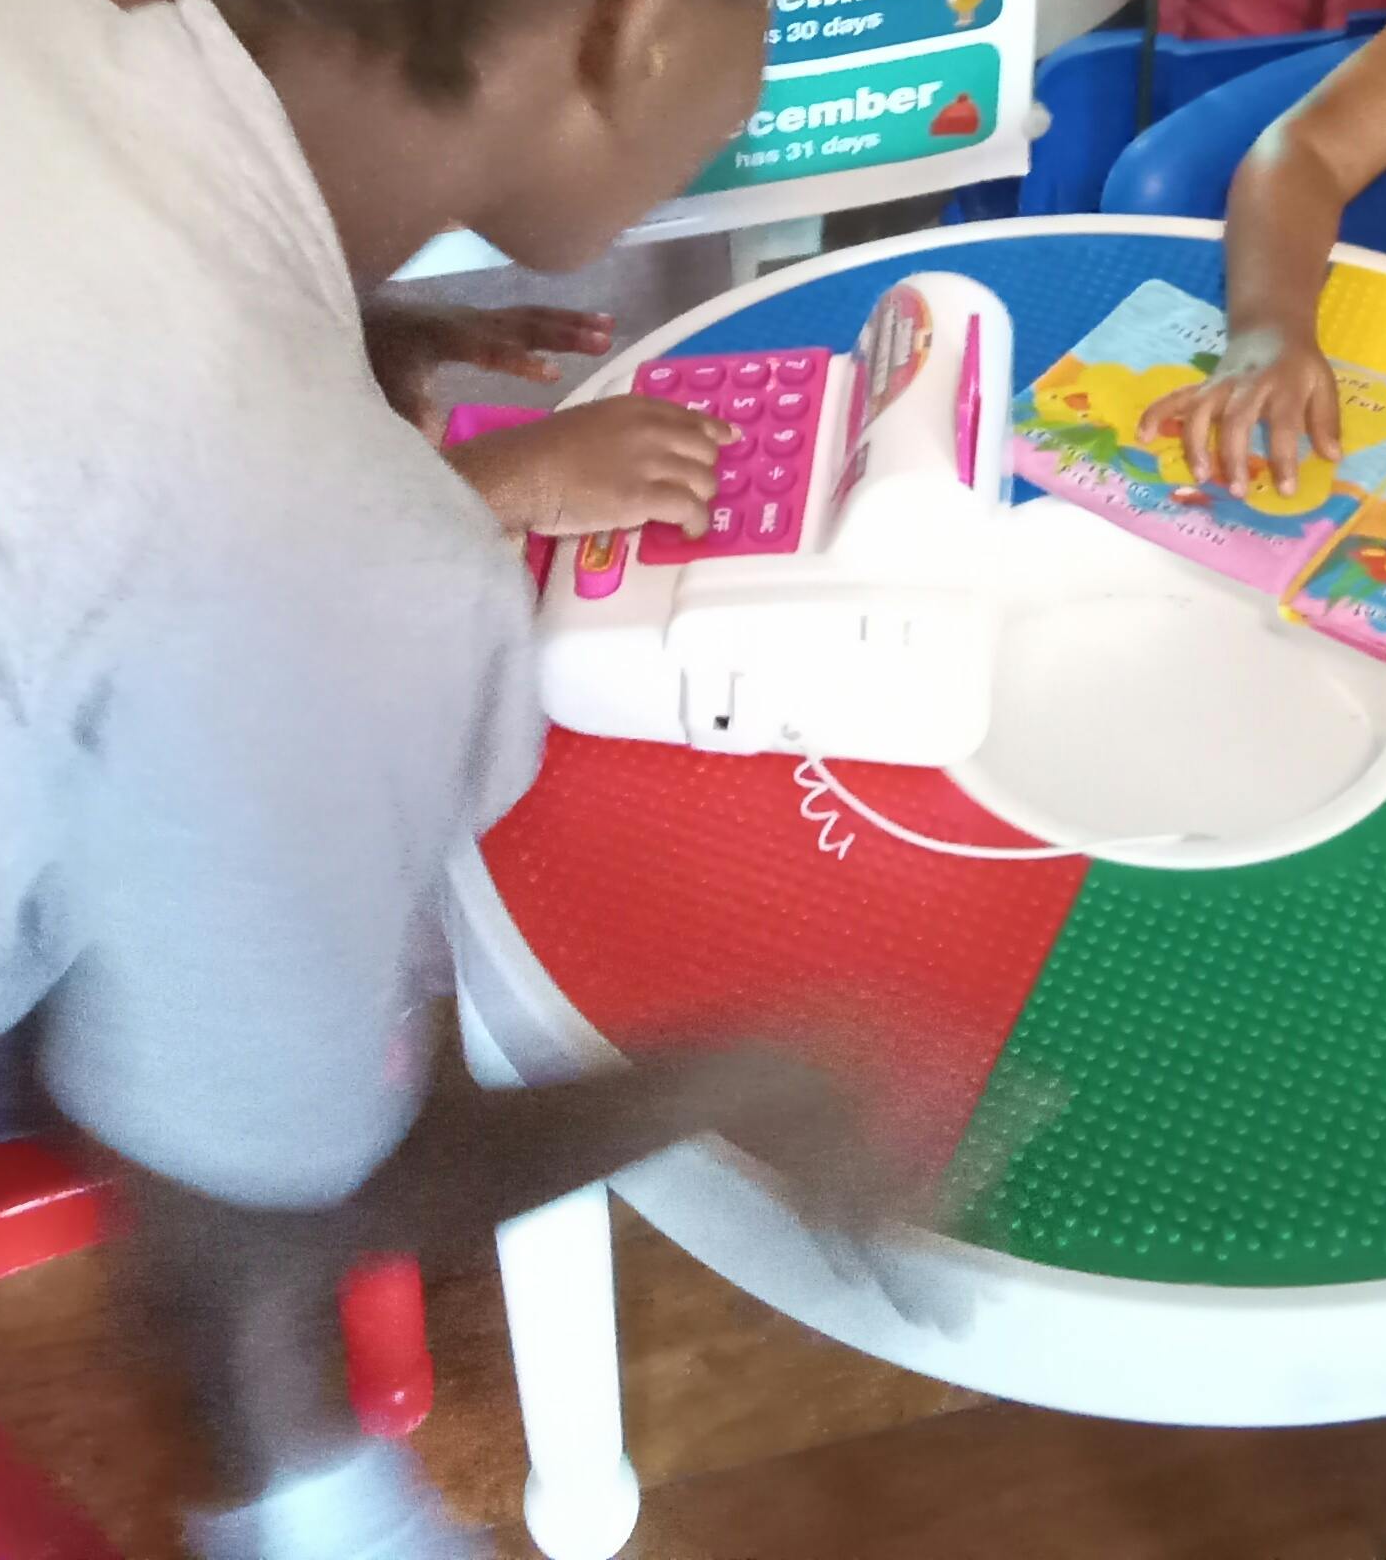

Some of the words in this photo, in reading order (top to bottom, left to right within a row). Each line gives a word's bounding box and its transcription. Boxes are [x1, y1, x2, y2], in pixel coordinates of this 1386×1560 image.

[786, 19, 821, 43] 30
[823, 12, 886, 36] days
[785, 139, 815, 163] 31
[821, 132, 882, 155] days
